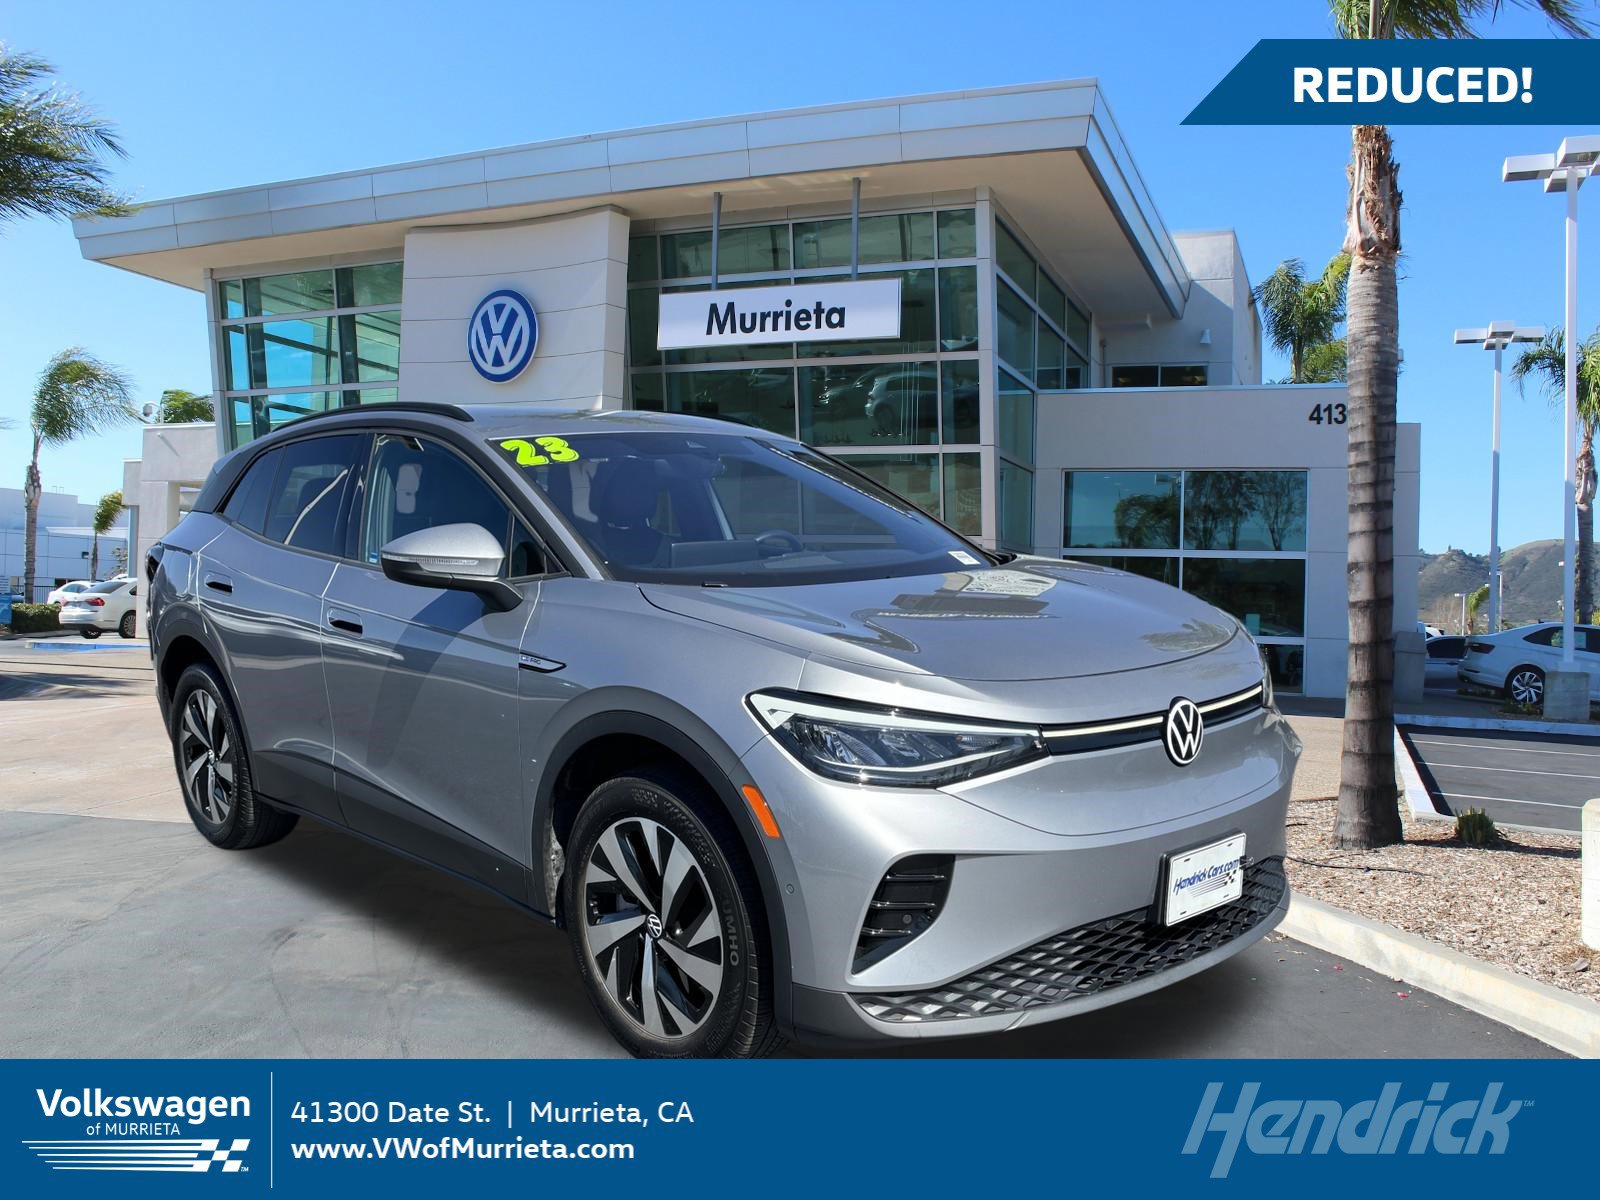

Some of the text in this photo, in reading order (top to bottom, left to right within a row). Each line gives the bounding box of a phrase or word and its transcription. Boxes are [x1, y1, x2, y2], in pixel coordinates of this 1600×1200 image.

[705, 300, 846, 336] Murrieta
[1308, 403, 1347, 425] 413
[500, 436, 579, 467] 23
[720, 891, 740, 967] UMHO
